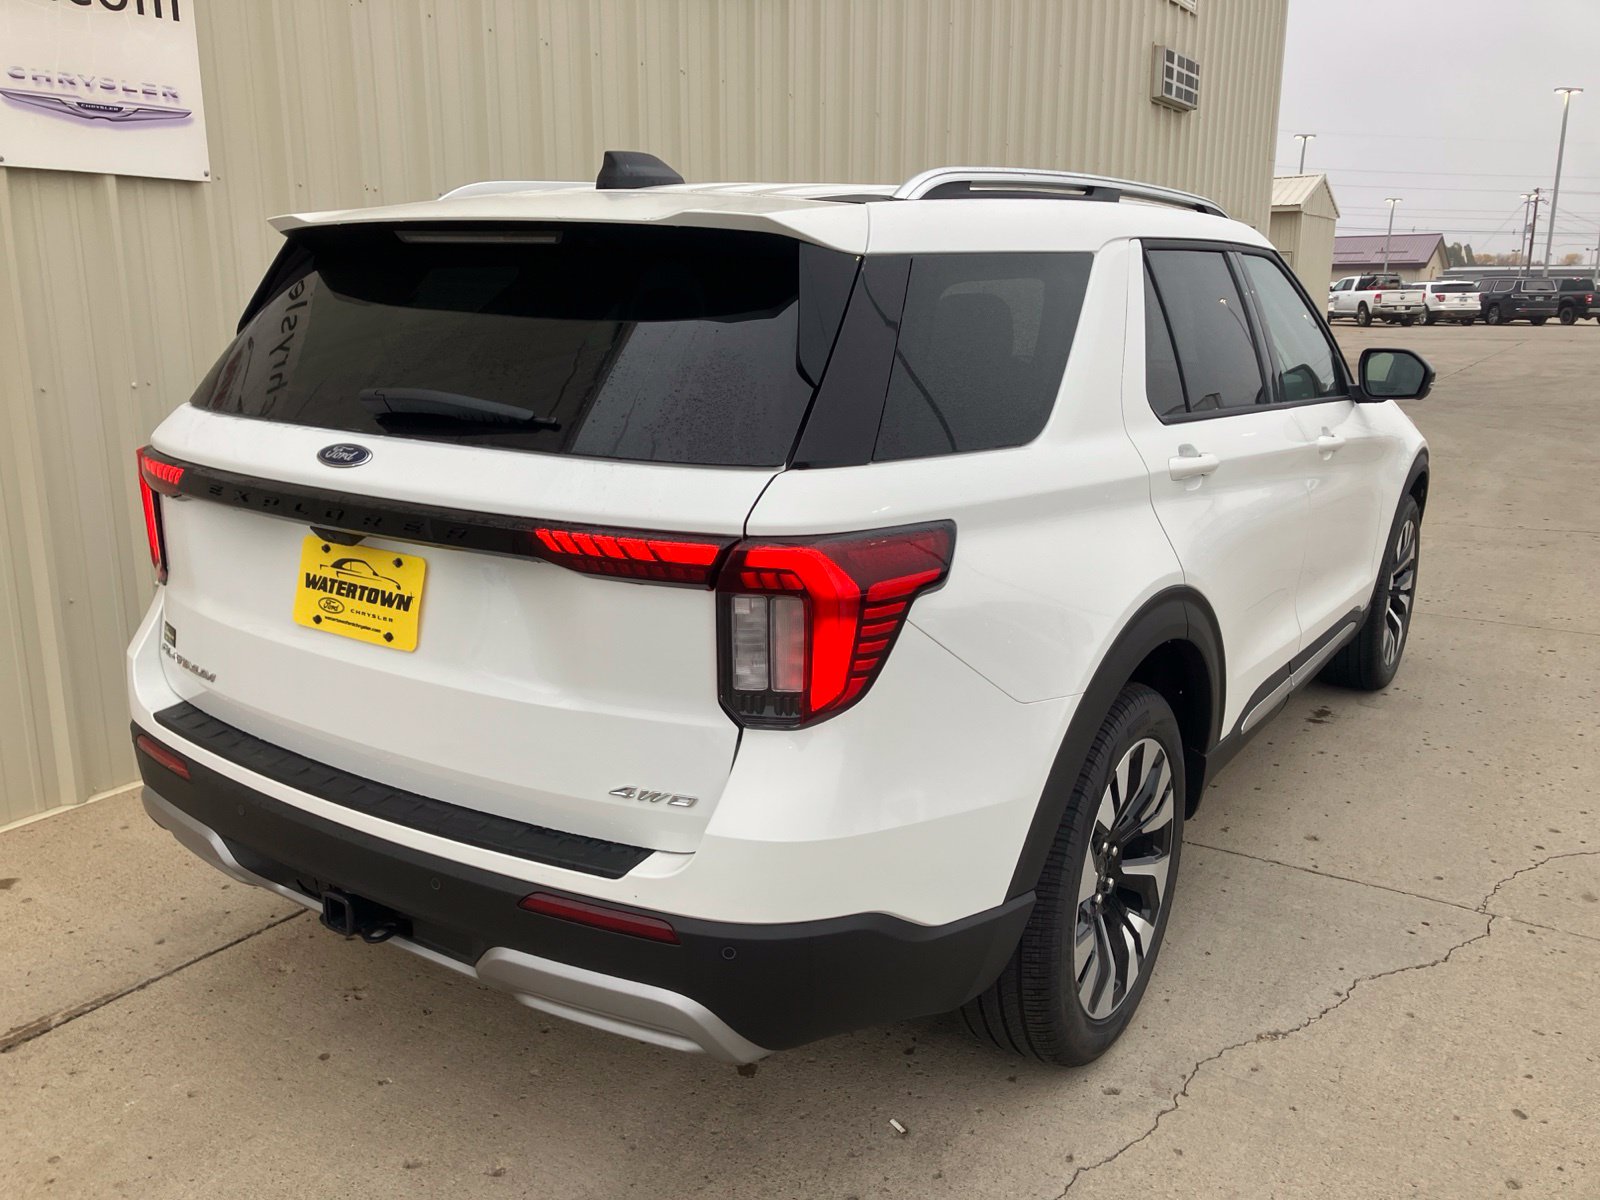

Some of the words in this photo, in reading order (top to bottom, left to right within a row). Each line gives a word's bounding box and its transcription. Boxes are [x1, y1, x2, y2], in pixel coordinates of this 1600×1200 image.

[8, 66, 178, 99] CHRYSLER
[305, 572, 412, 612] WATERTOWN
[350, 608, 394, 623] CHRYSLER
[608, 785, 699, 807] 4WD
